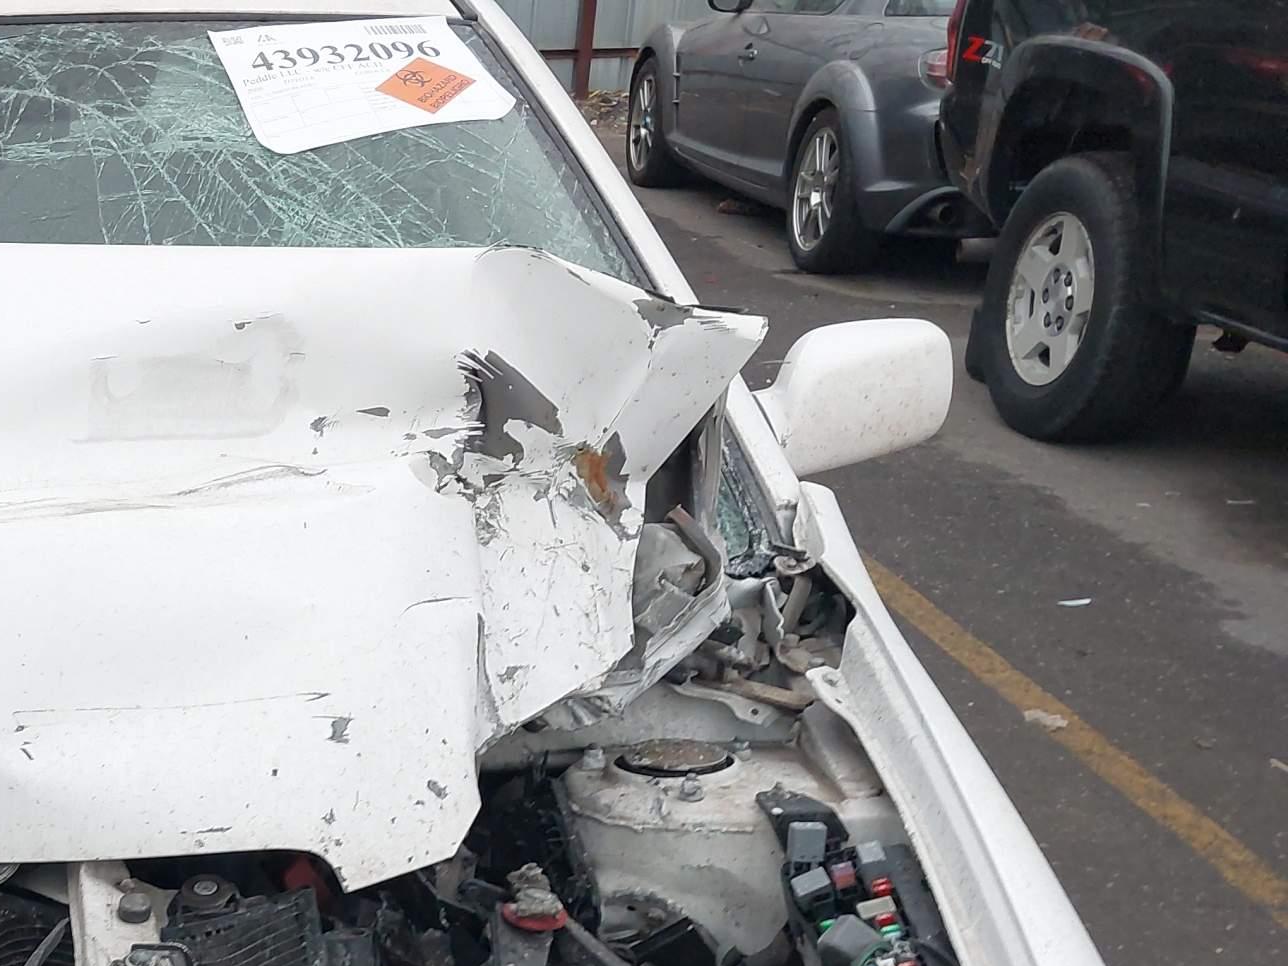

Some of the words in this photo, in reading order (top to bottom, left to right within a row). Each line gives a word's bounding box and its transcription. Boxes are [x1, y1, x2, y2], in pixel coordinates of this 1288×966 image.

[251, 39, 441, 71] 43932096
[962, 36, 1003, 61] Z71
[242, 73, 278, 88] Peddle
